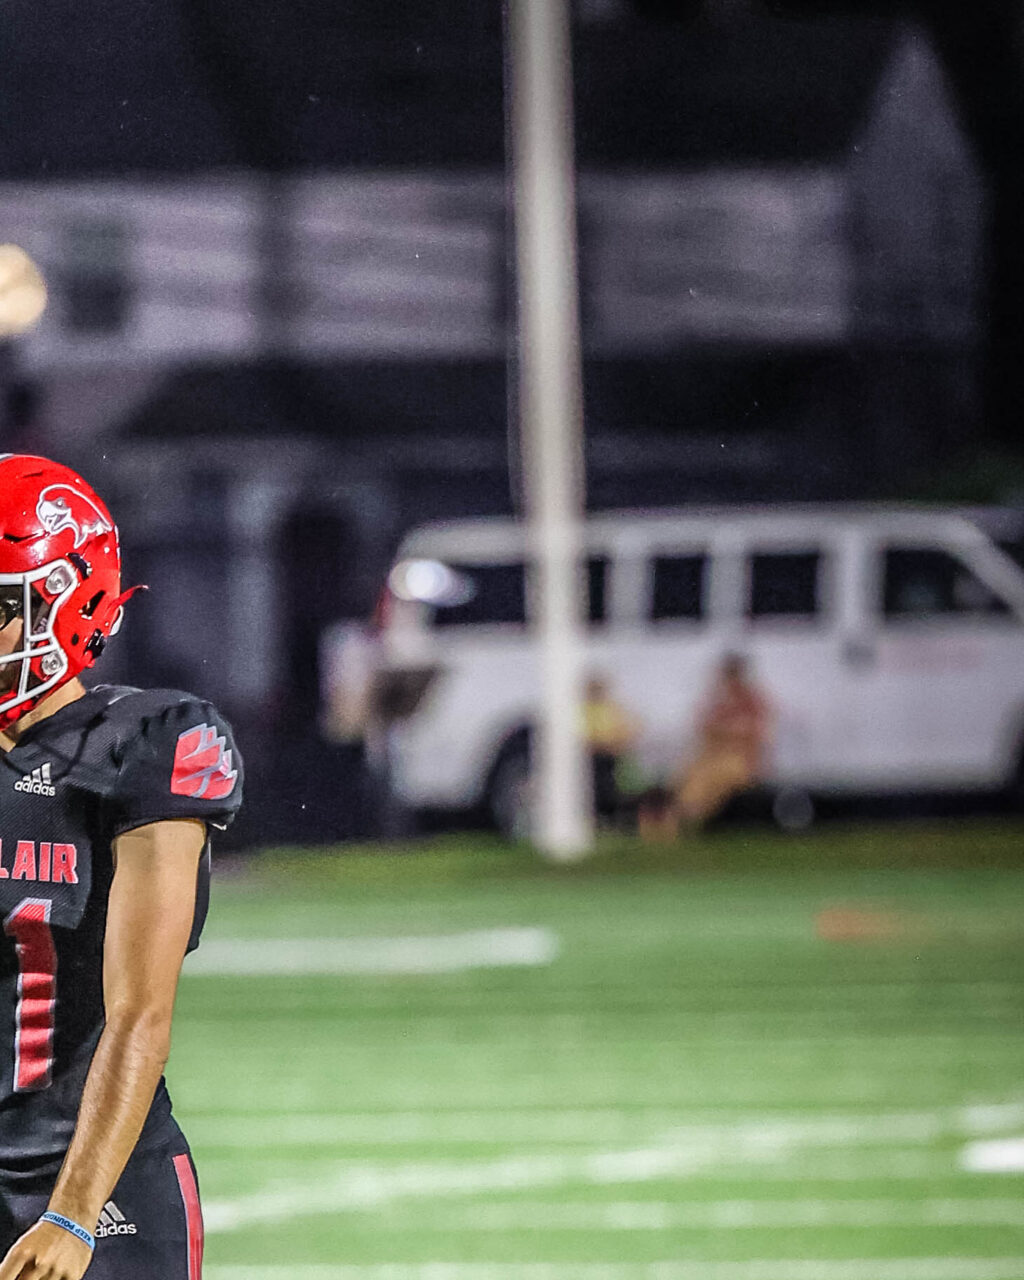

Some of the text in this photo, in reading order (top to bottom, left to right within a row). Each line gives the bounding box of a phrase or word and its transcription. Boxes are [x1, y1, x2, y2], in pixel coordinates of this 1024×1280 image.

[14, 779, 56, 797] adidas
[75, 1228, 92, 1242] KEEP
[94, 1222, 137, 1238] didas
